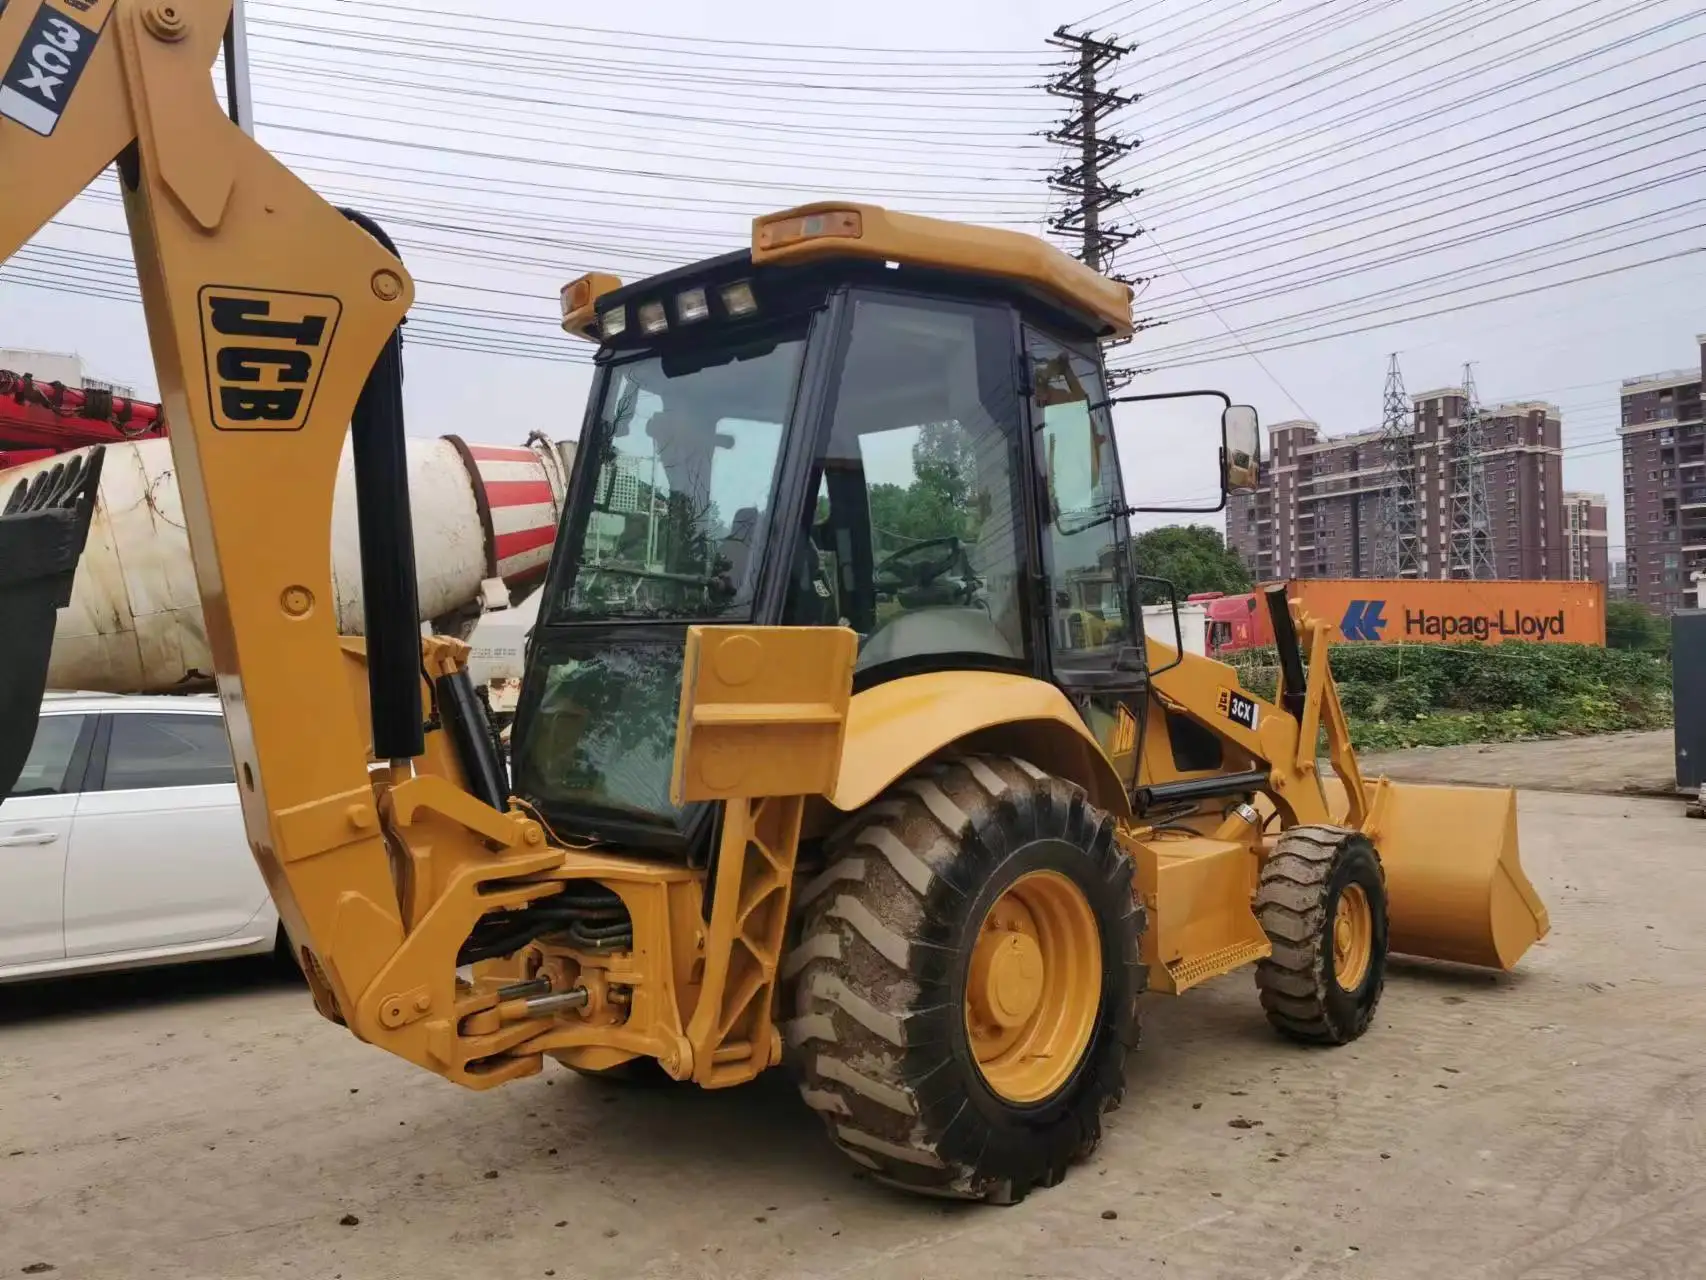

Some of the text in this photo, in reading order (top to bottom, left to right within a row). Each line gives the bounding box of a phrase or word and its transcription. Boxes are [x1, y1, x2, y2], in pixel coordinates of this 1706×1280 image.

[17, 18, 81, 102] 3CX
[208, 296, 328, 421] JCB
[1405, 609, 1565, 641] Hapag-Lloyd
[1217, 691, 1228, 712] JCB
[1231, 697, 1251, 721] 3CX
